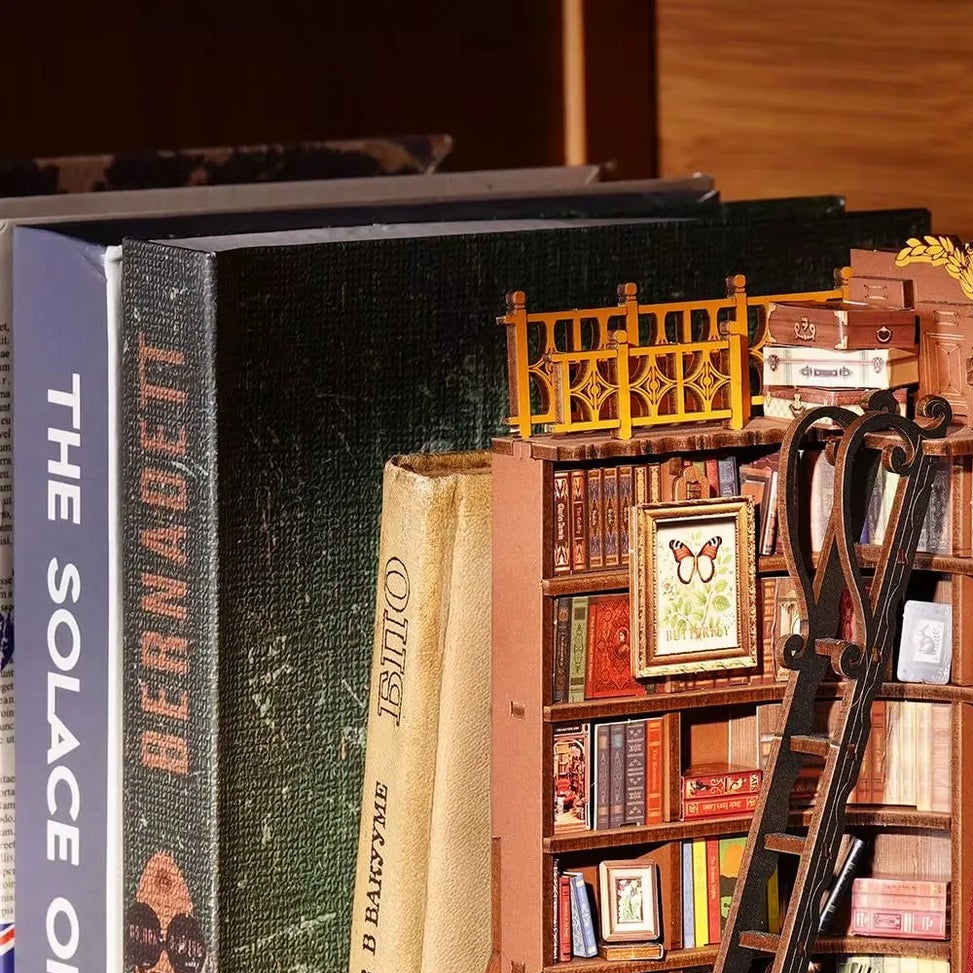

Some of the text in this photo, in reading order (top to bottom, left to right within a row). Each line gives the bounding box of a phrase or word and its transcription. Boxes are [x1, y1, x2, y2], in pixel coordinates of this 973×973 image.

[47, 374, 81, 525] THE
[138, 333, 189, 776] BERNADETT
[47, 559, 81, 866] SOLACE
[377, 556, 411, 728] БПО
[364, 781, 388, 929] ВАКУУМЕ
[362, 933, 377, 956] В
